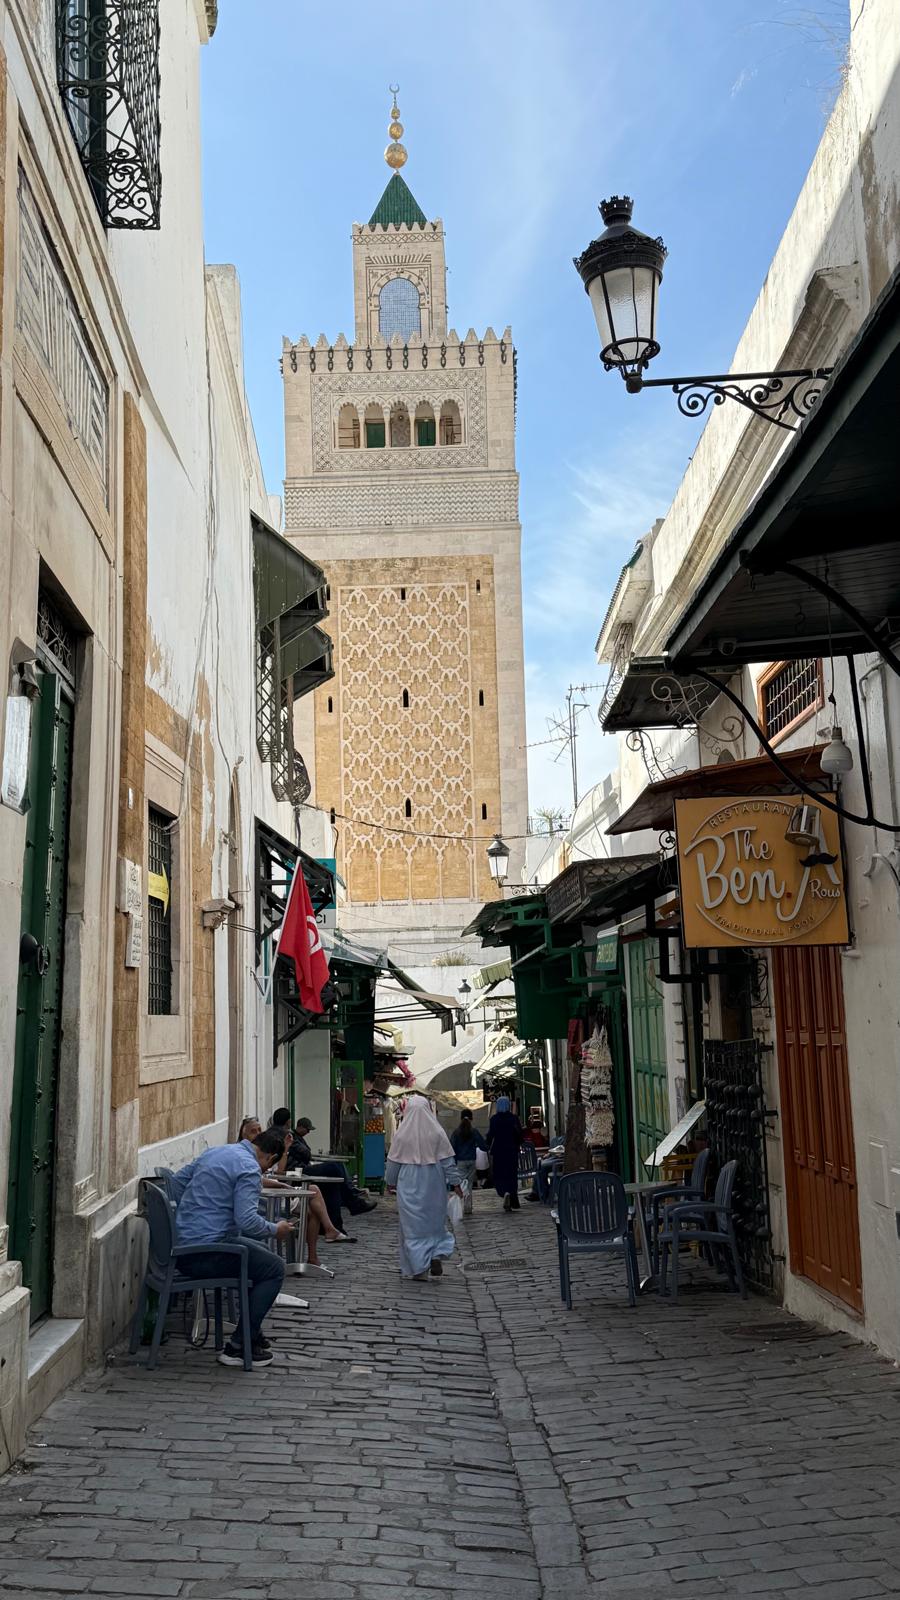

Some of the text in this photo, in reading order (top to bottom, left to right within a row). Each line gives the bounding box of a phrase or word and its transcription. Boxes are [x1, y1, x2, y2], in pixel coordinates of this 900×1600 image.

[709, 802, 793, 829] RESTAURAN
[722, 826, 774, 862] The
[808, 878, 841, 900] Rous
